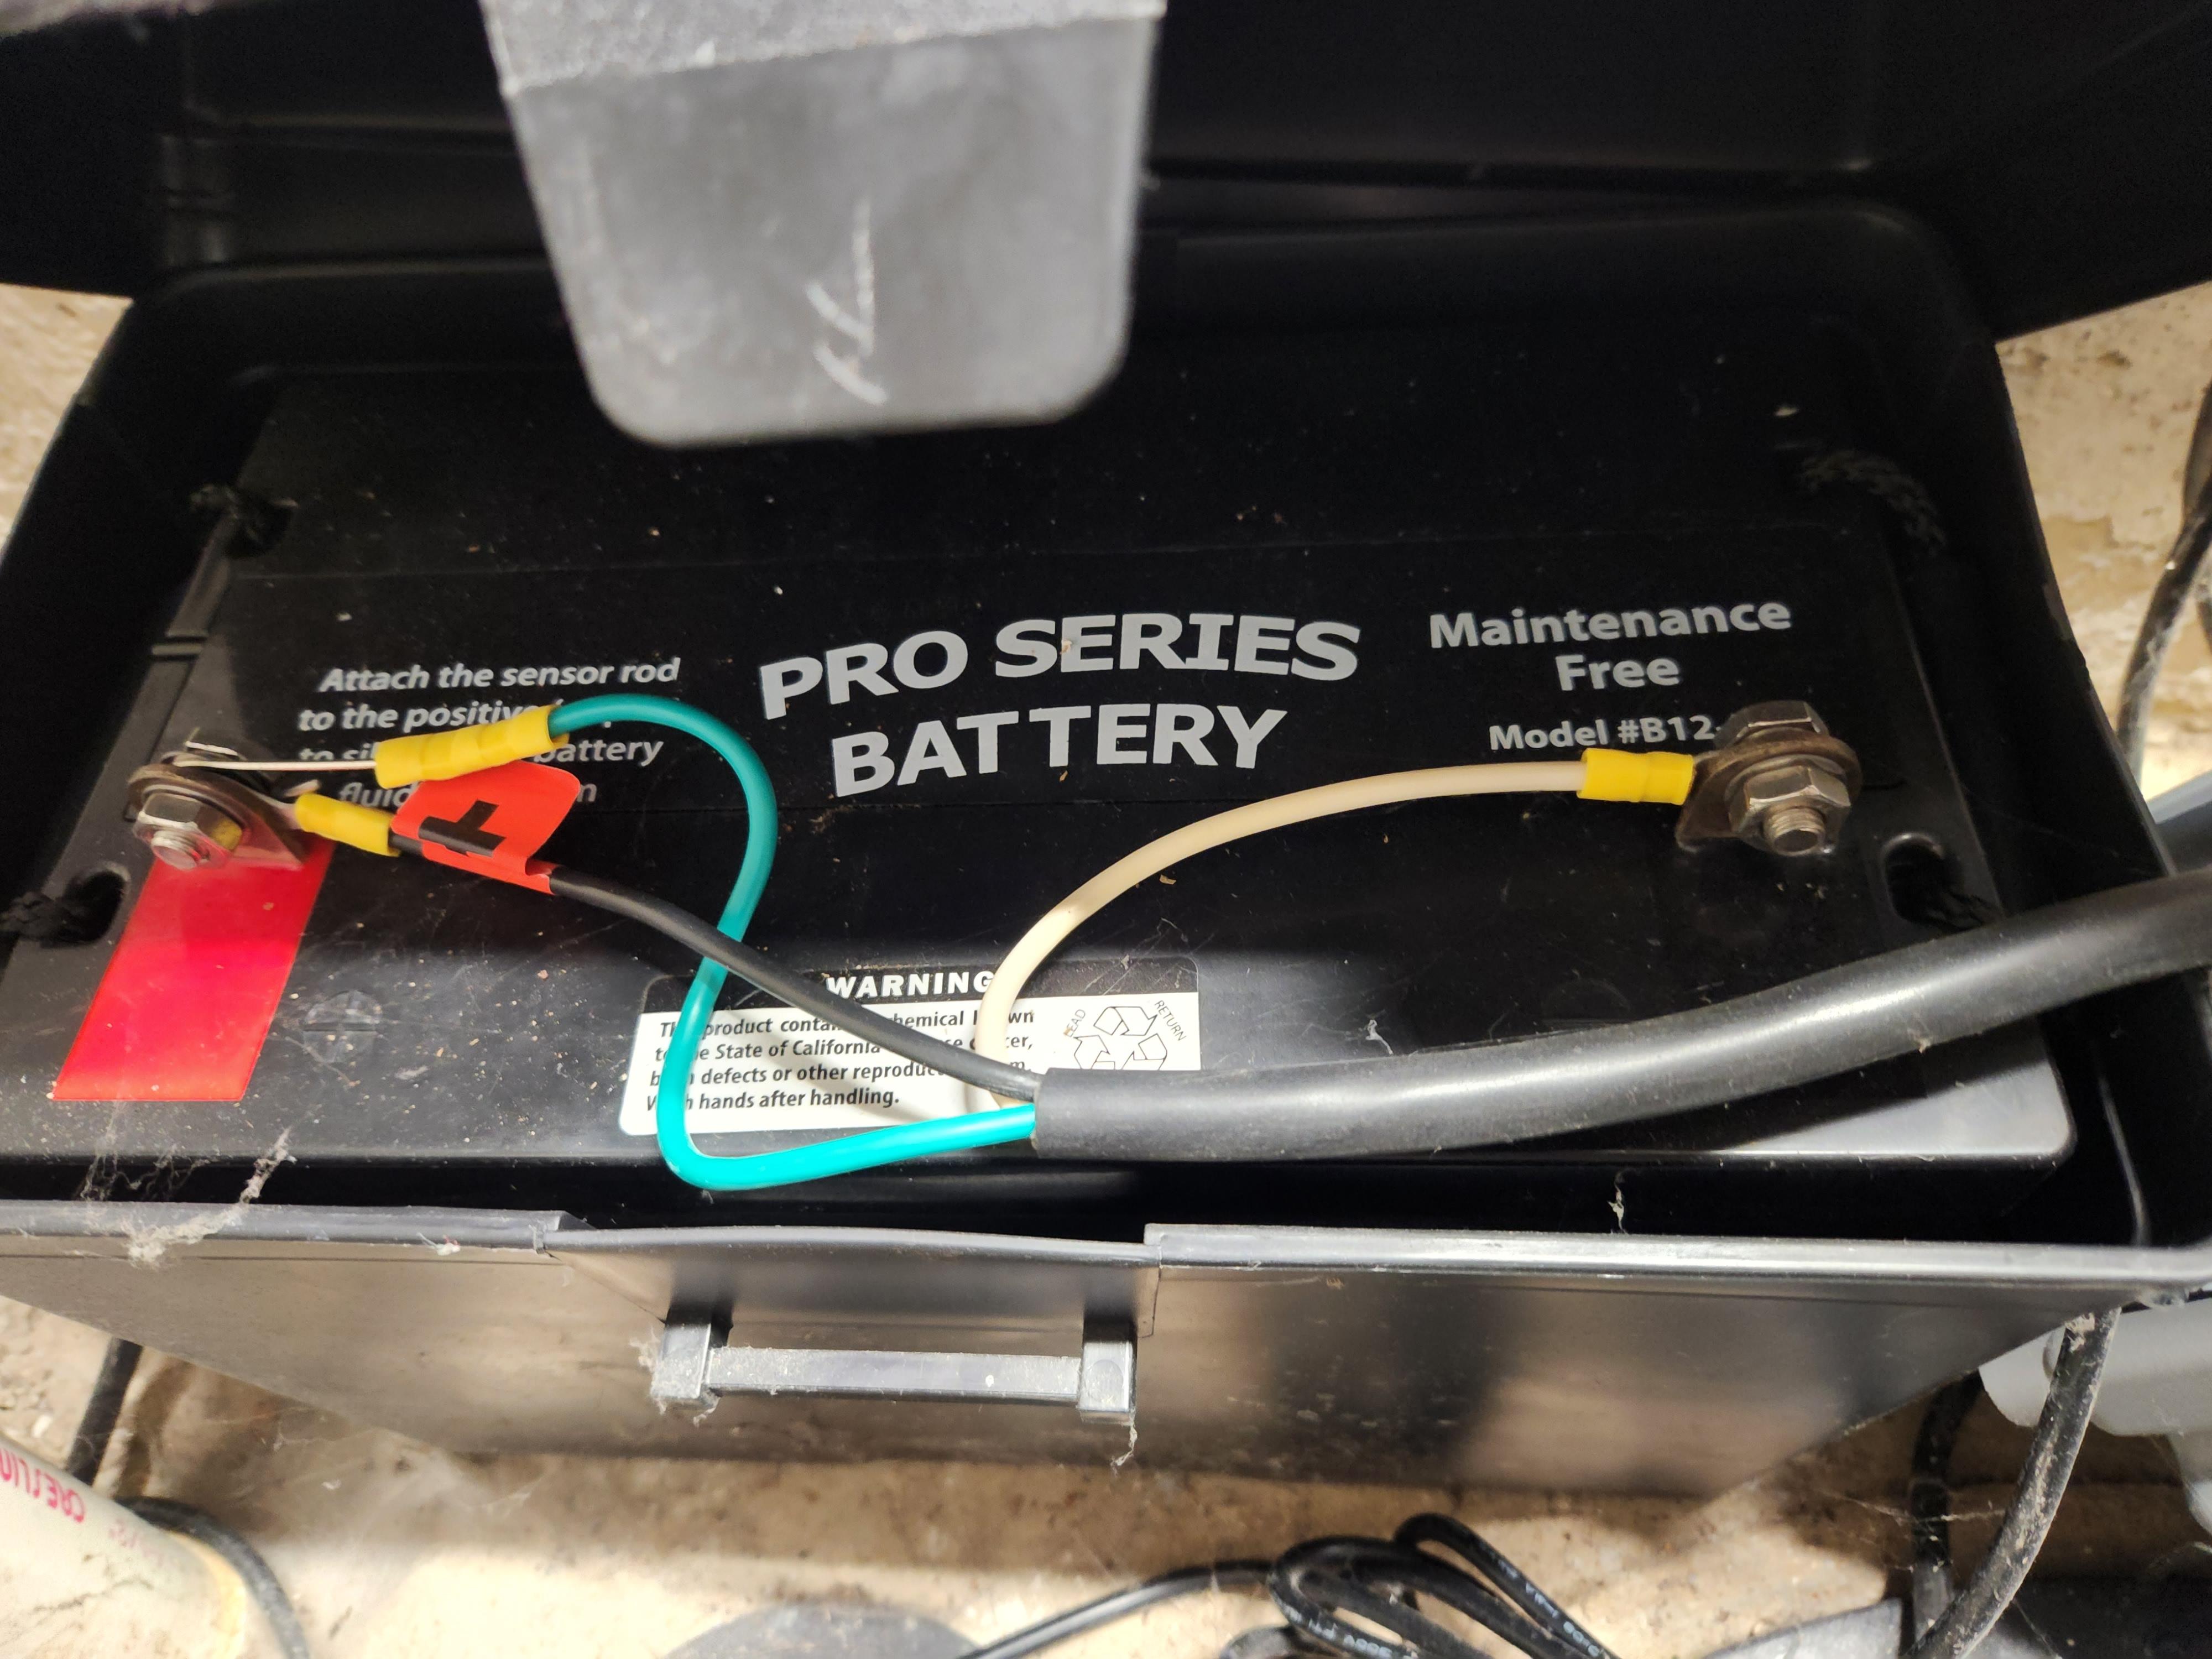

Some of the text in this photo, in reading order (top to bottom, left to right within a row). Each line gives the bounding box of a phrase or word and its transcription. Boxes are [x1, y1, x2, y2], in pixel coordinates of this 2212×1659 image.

[1429, 601, 1792, 648] Maintenance
[318, 657, 681, 692] Attach the sensor rod
[759, 629, 969, 720] PRO
[995, 613, 1362, 681] SERIES
[1555, 654, 1681, 691] Free
[299, 709, 335, 732] to
[341, 703, 399, 729] the
[402, 700, 540, 734] positiv
[832, 703, 1288, 797] BATTERY
[1489, 719, 1609, 750] Model
[826, 971, 994, 999] WARNING
[701, 1018, 773, 1041] product
[889, 1010, 964, 1029] hemical
[1154, 1000, 1187, 1041] RETURN
[714, 1042, 762, 1060] State
[768, 1039, 789, 1057] of
[792, 1039, 881, 1056] California
[701, 1067, 767, 1084] defects
[773, 1068, 792, 1082] or
[796, 1063, 848, 1081] other
[698, 1092, 754, 1110] hands
[759, 1088, 806, 1108] after
[810, 1088, 900, 1108] handling.
